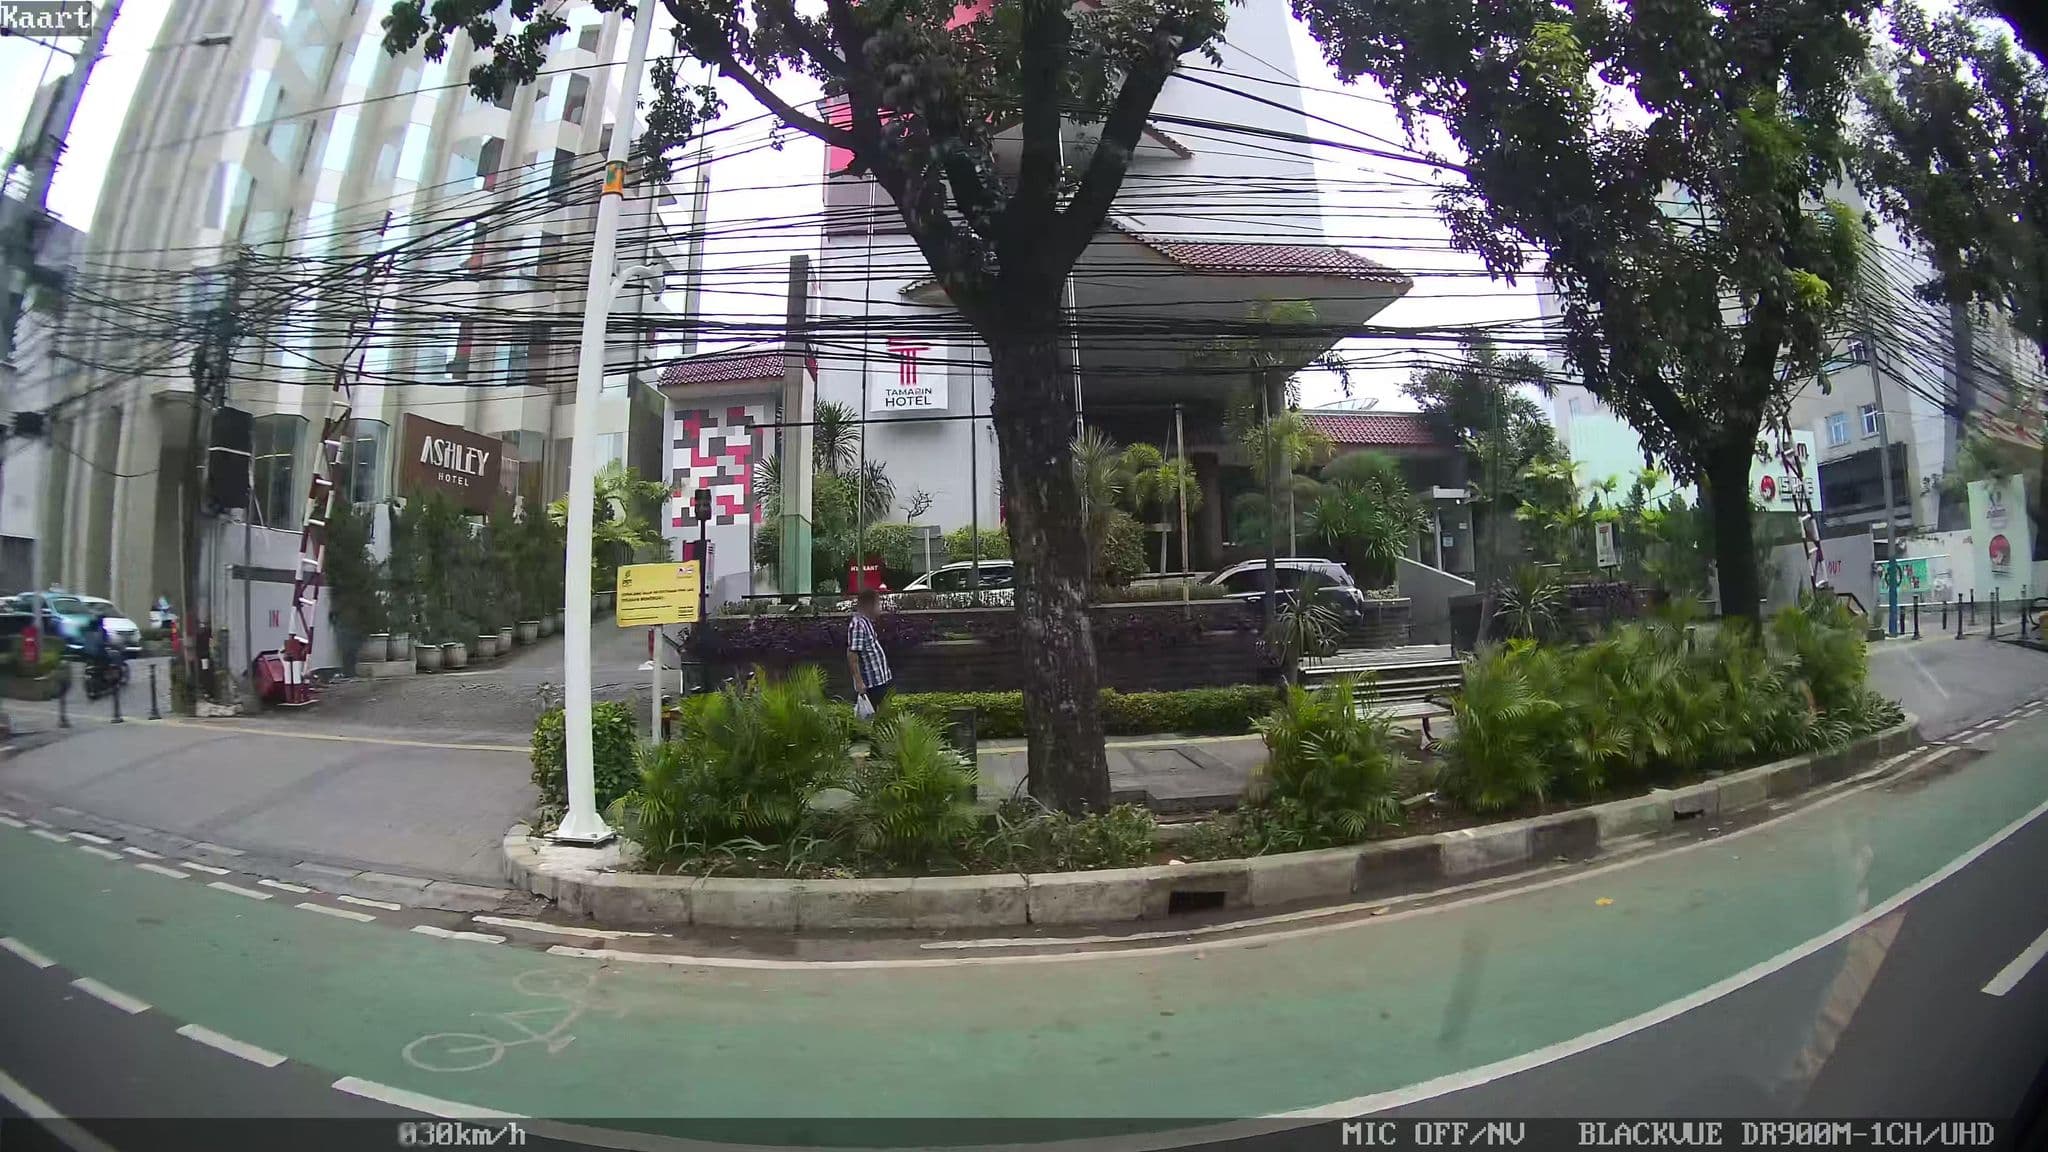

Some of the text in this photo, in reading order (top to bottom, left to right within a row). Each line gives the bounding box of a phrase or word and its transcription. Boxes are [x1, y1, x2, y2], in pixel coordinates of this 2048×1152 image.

[885, 388, 932, 396] TAMARIN
[885, 396, 932, 407] HOTEL
[420, 435, 490, 477] ASHLEY
[438, 472, 469, 487] HOTEL
